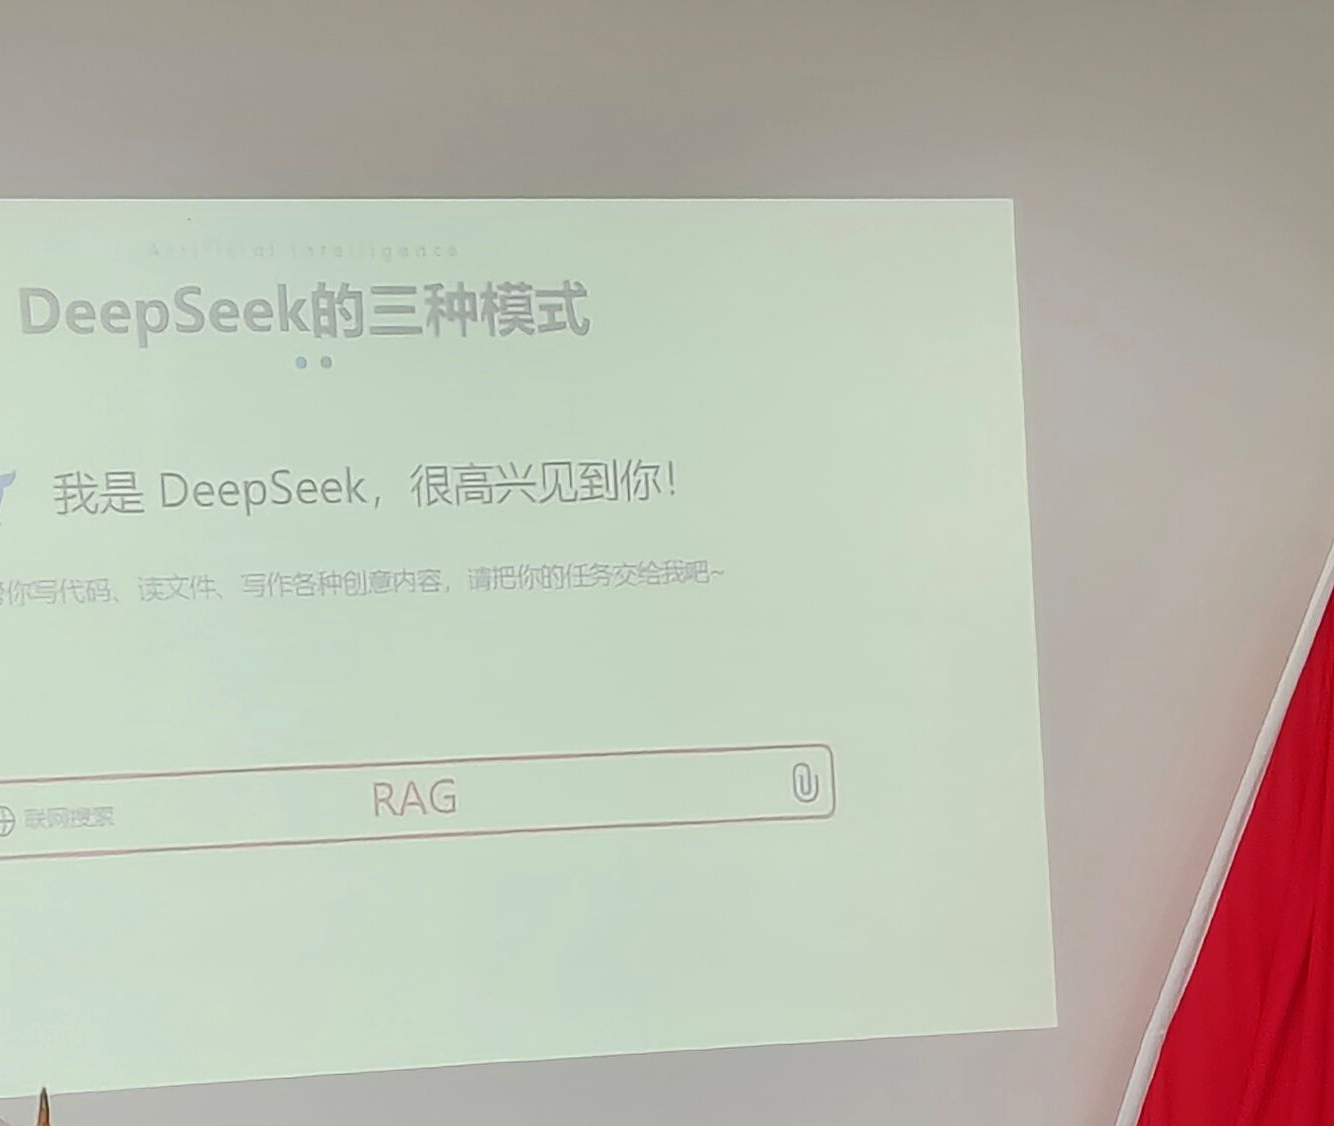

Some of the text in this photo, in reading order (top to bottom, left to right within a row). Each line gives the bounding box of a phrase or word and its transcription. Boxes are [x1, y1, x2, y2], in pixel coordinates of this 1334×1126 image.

[19, 280, 591, 349] DeepSeek的三种模式
[53, 470, 145, 516] 我是
[24, 805, 115, 829] 联网搜索
[373, 779, 456, 817] RAG
